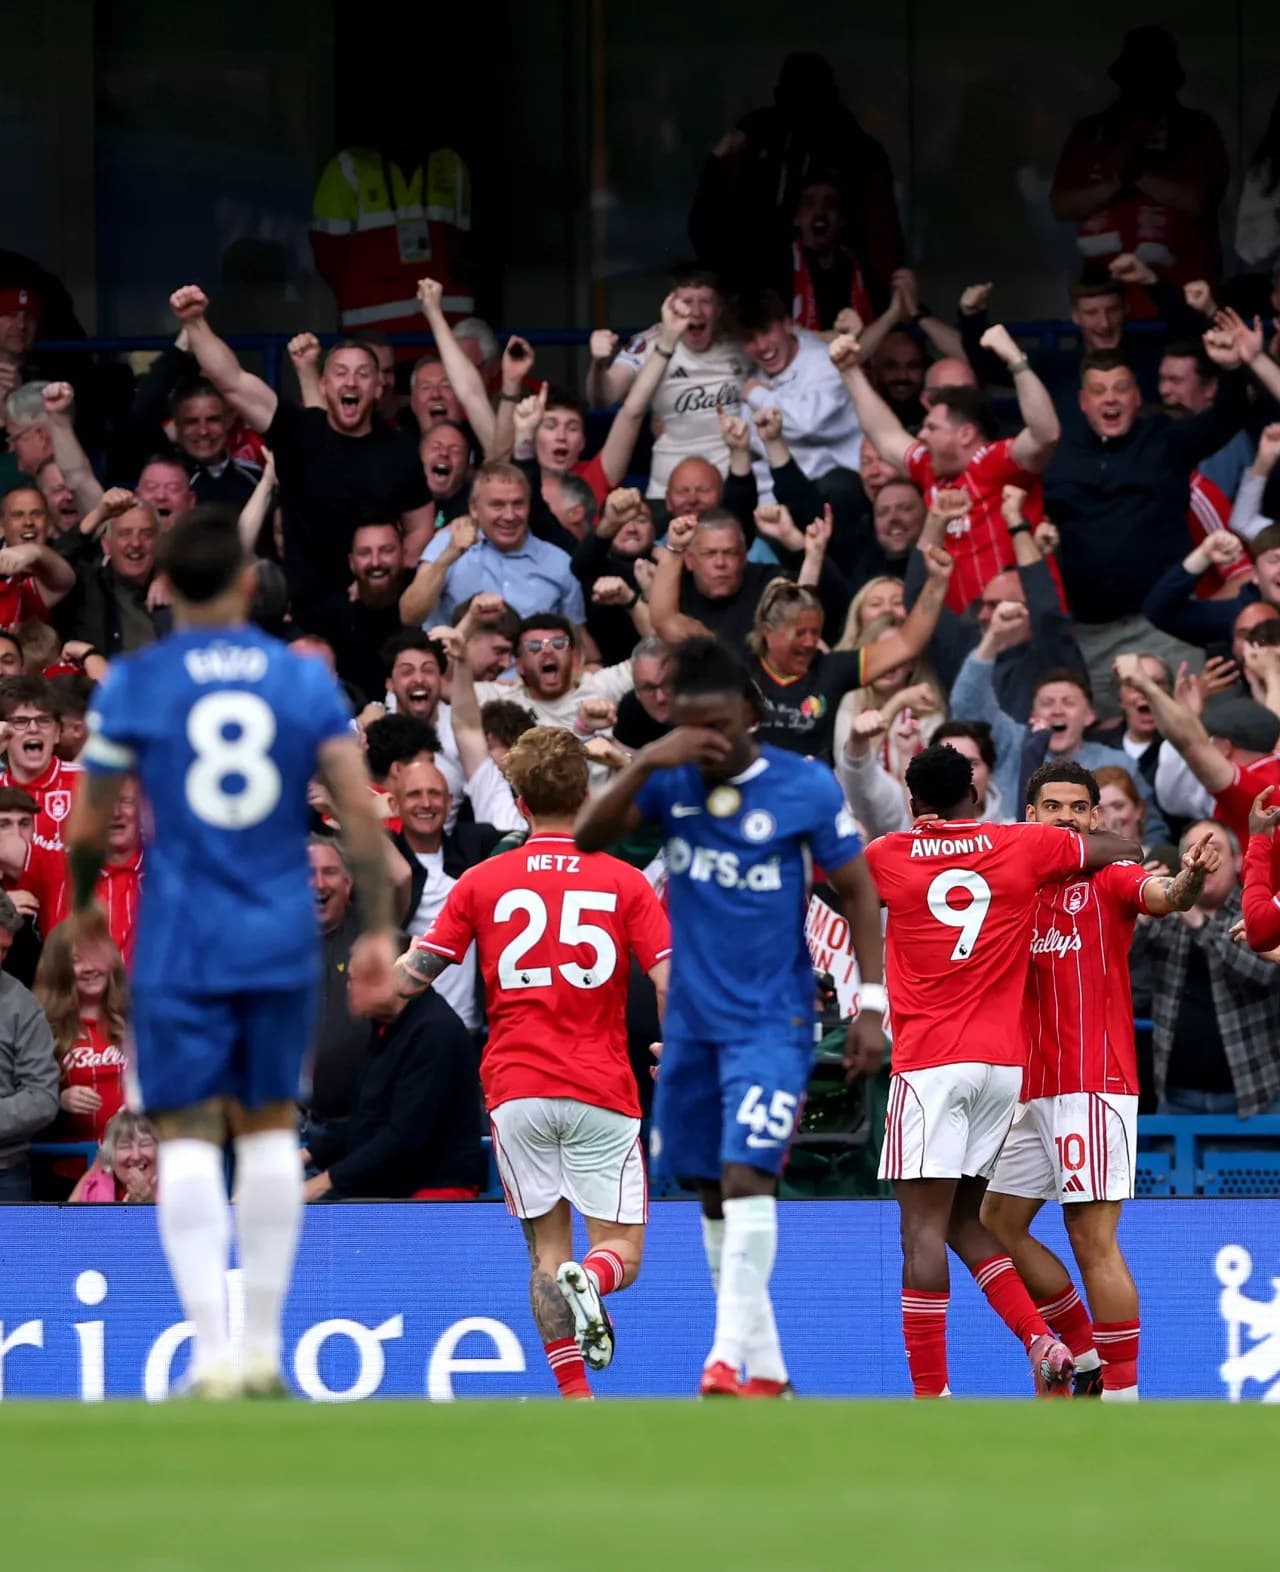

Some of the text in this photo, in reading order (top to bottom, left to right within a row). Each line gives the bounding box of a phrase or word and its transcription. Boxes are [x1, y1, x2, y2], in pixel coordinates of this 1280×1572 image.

[186, 690, 283, 831] 8
[526, 854, 581, 873] NETZ
[910, 834, 993, 857] AWONIYI
[493, 888, 617, 990] 25
[927, 868, 992, 961] 9
[736, 1085, 797, 1139] 45
[1055, 1133, 1086, 1172] 10
